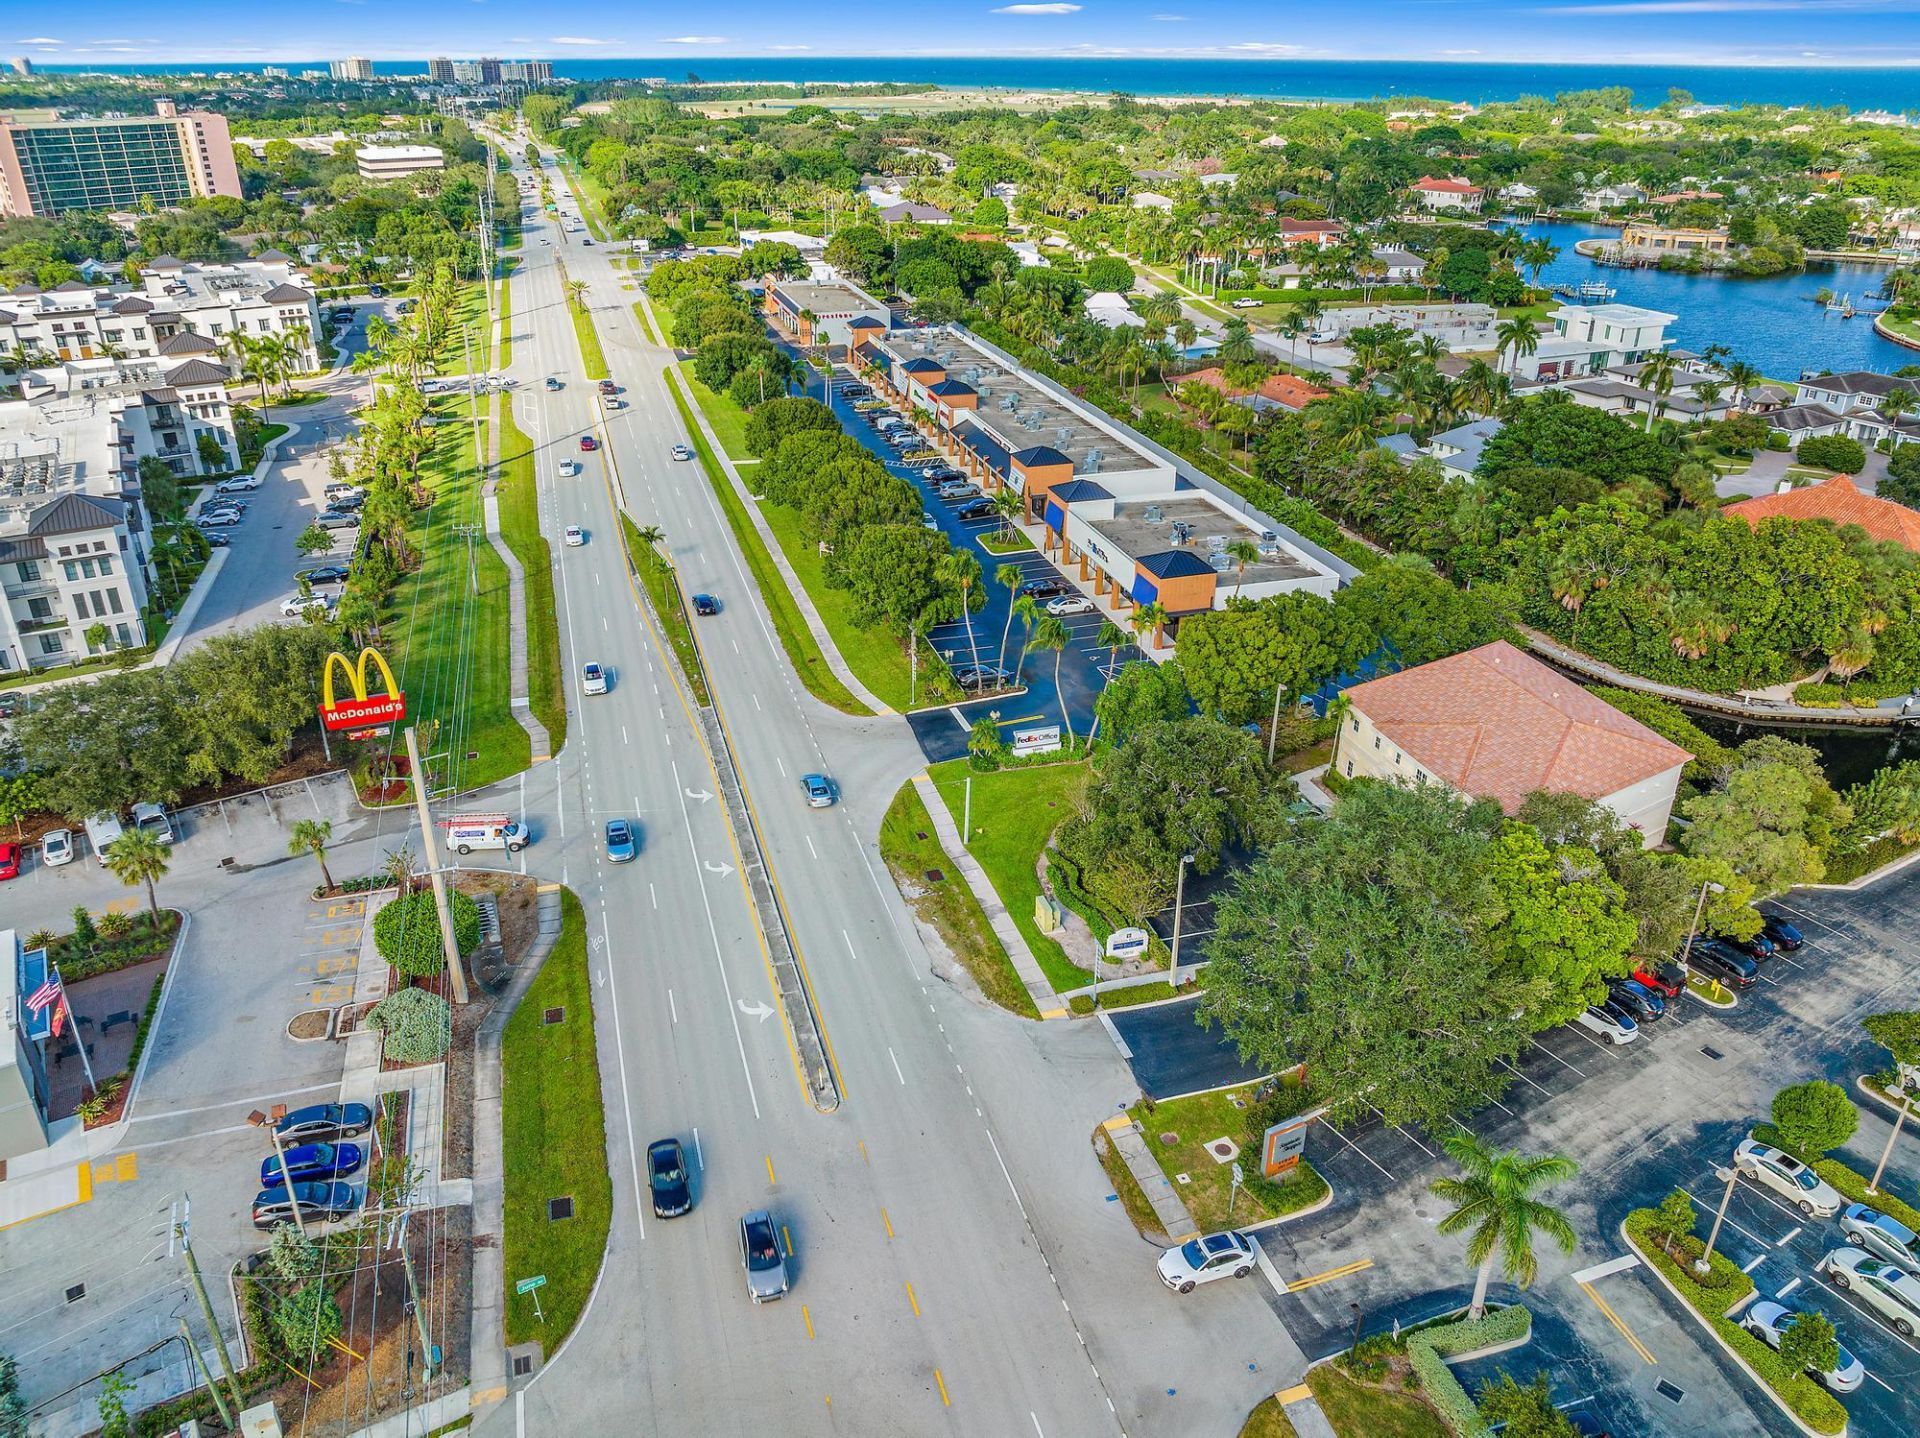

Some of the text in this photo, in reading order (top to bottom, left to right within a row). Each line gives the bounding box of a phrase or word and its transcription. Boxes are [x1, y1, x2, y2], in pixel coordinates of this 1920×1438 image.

[327, 702, 403, 722] McDonald's
[1017, 733, 1058, 744] FedEx Office
